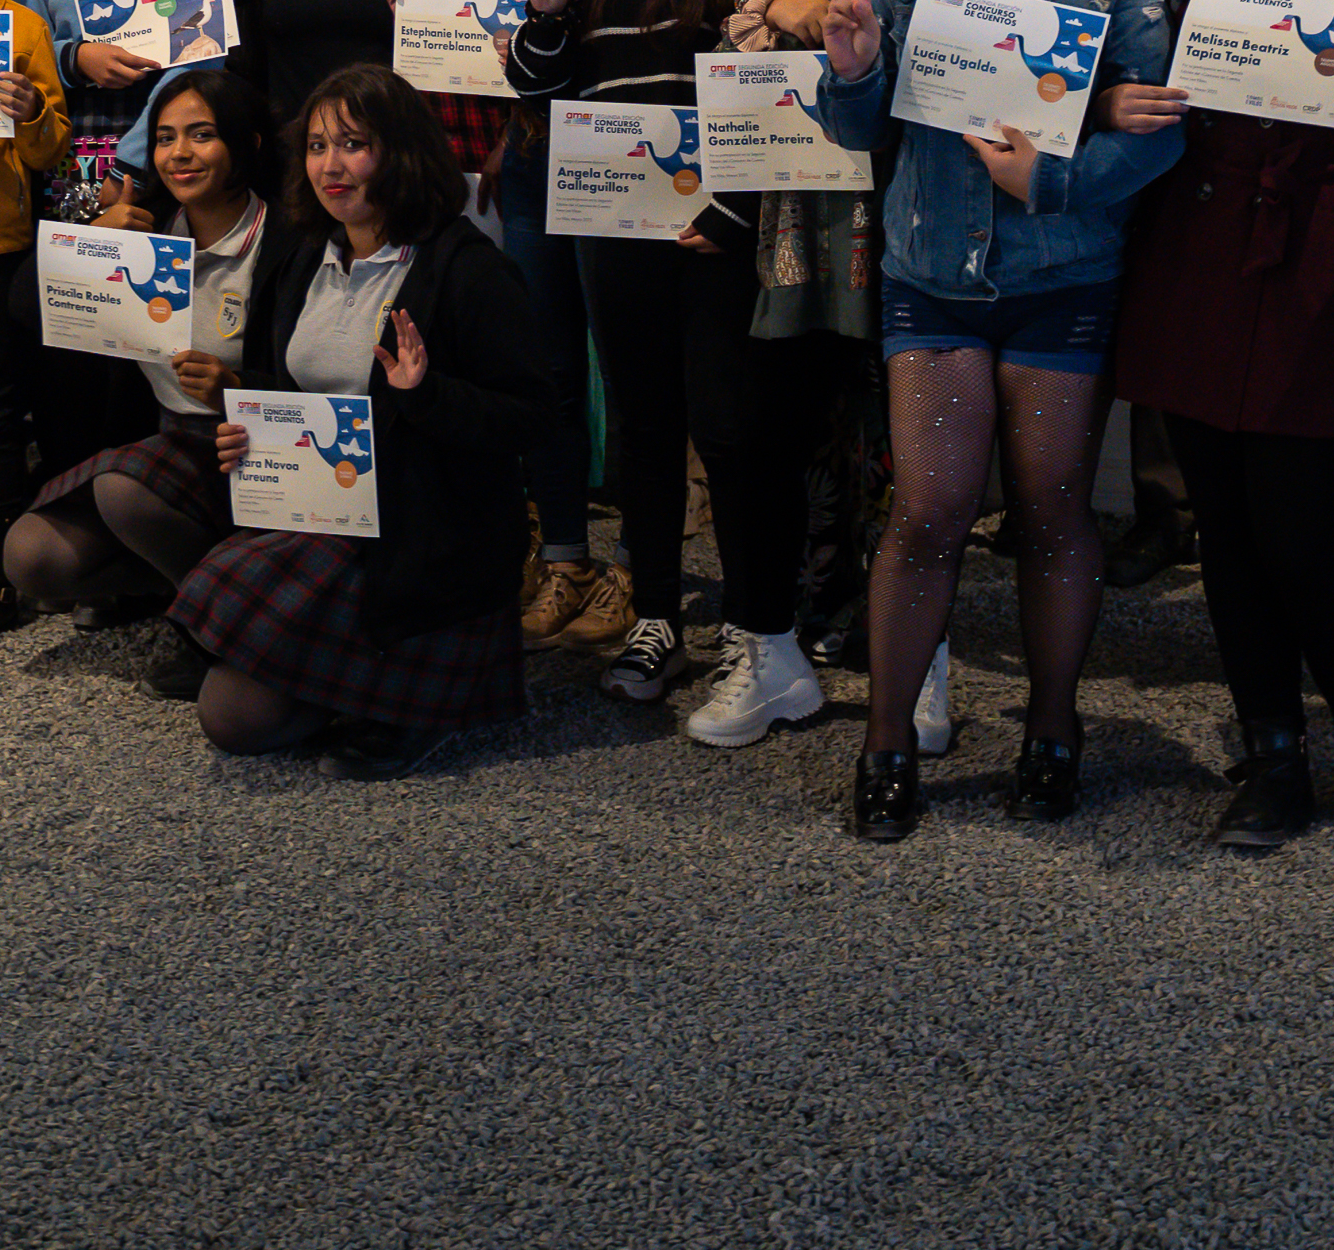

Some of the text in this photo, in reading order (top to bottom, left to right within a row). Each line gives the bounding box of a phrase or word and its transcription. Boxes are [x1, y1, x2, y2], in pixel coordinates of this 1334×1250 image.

[966, 2, 1016, 19] CONCURSO
[964, 9, 1017, 27] DE CUENTOS
[92, 27, 152, 45] Abigail Novoa
[401, 26, 488, 41] Estephanie Ivonne
[401, 38, 482, 52] Pino Torreblanca
[1188, 32, 1290, 56] Melissa Beatriz
[913, 45, 997, 74] Lucía Ugalde
[1186, 45, 1261, 67] Tapia Tapia
[910, 59, 946, 77] Tapia
[751, 76, 788, 84] CUENTOS
[566, 112, 593, 120] amar
[595, 120, 640, 128] CONCURSO
[606, 127, 643, 135] CUENTOS
[708, 121, 760, 133] Nathalie
[708, 133, 814, 146] González Pereira
[557, 167, 645, 181] Angela Correa
[557, 180, 629, 194] Galleguillos
[77, 242, 119, 253] CONCURSO
[88, 250, 121, 260] CUENTOS
[47, 297, 98, 313] Contreras
[85, 291, 122, 305] Robles
[263, 408, 301, 417] CONCURSO
[238, 458, 299, 471] Sara Novoa
[238, 471, 279, 483] Tureuna
